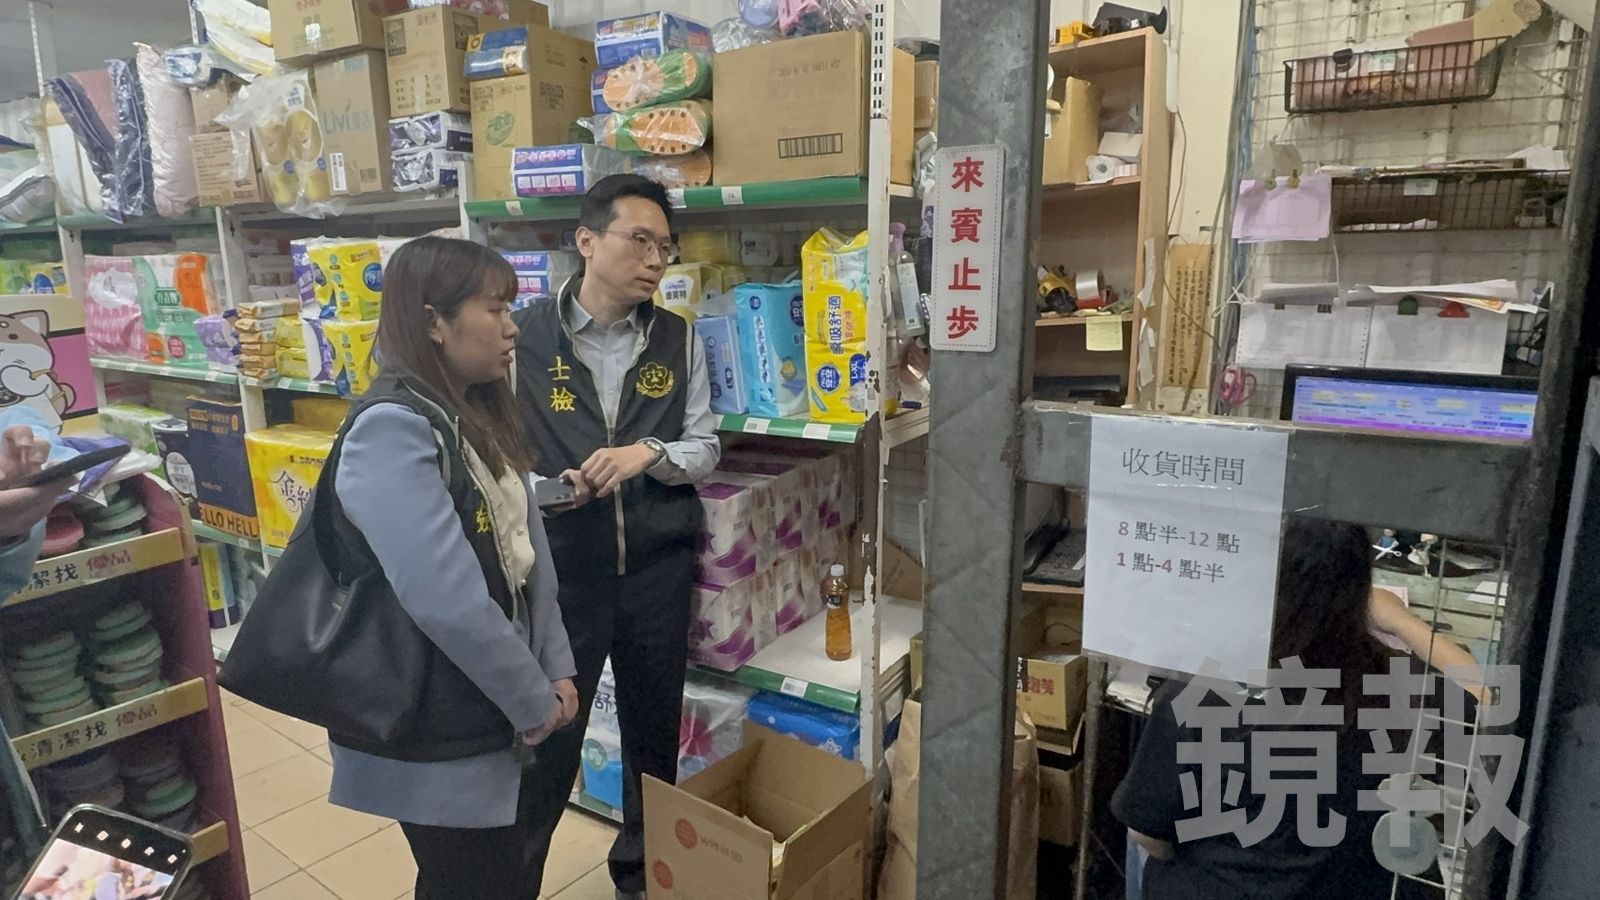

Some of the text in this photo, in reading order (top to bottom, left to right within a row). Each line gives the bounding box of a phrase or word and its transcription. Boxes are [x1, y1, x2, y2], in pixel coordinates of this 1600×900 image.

[547, 355, 577, 412] 士檢
[1122, 447, 1245, 486] 收貨時間
[227, 515, 260, 538] HELL
[1118, 521, 1129, 536] 8
[1116, 552, 1126, 567] 1
[16, 563, 79, 594] 潔找
[20, 720, 108, 761] 清潔找
